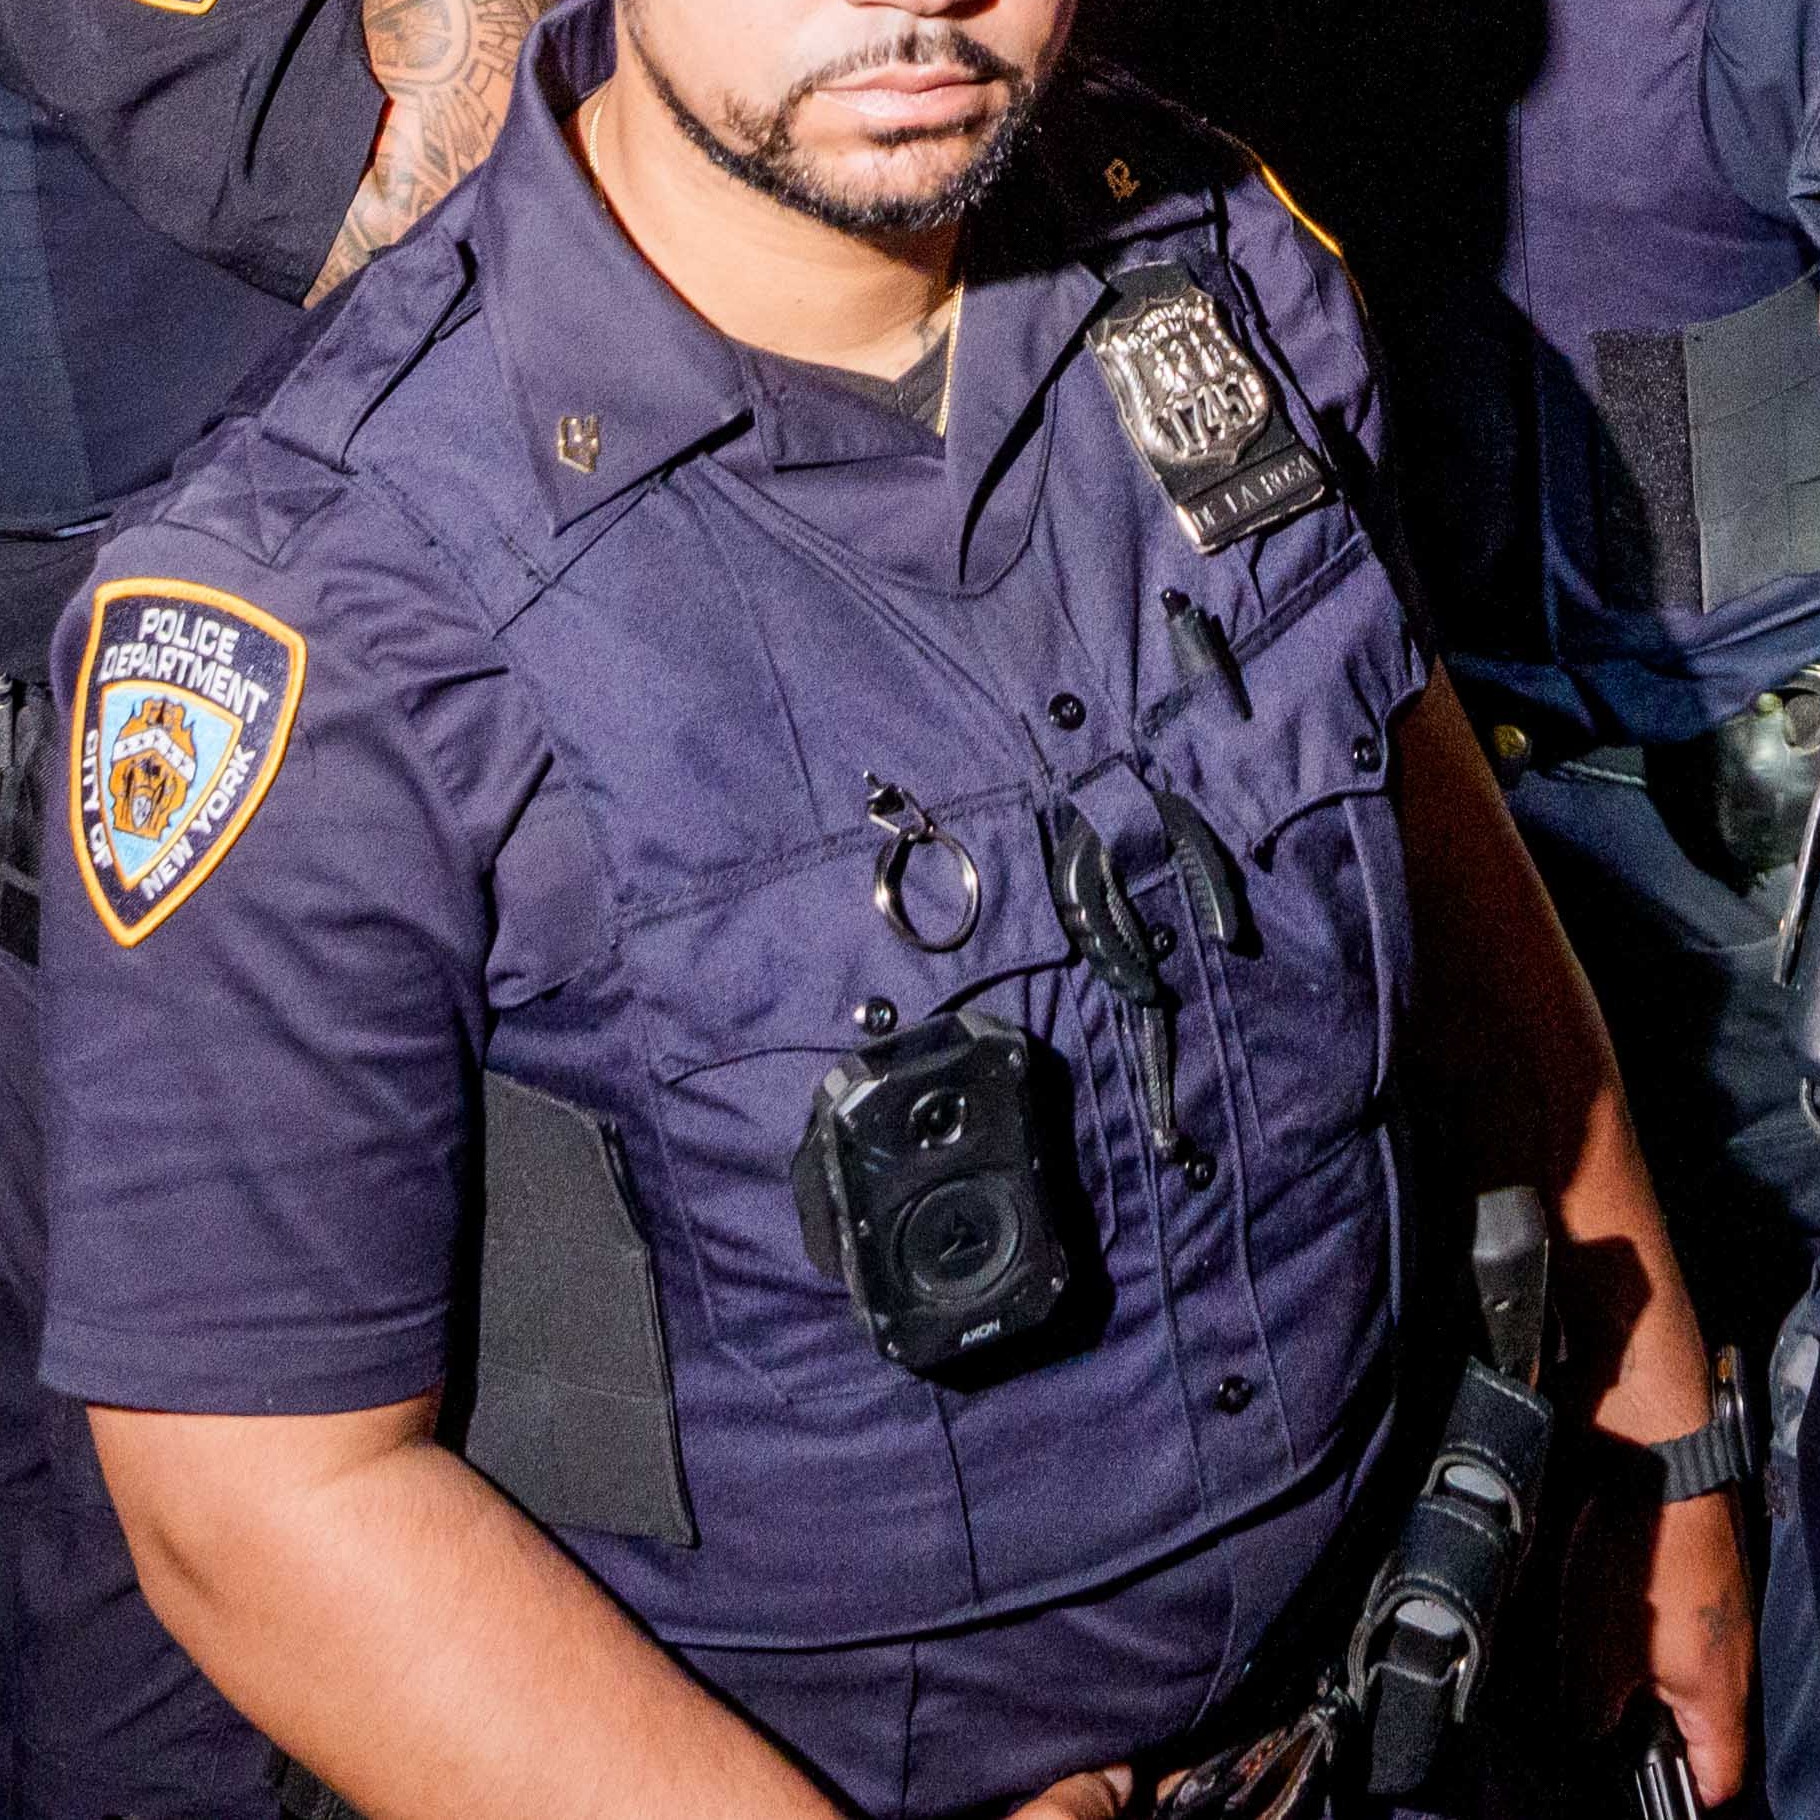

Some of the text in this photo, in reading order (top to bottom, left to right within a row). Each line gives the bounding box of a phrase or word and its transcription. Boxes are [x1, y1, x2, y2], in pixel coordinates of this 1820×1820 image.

[138, 607, 240, 663] POLICE
[101, 643, 270, 724] DEPARTMENT
[82, 728, 115, 869] CITY OF
[140, 743, 259, 902] NEW YORK
[960, 1319, 1001, 1347] AXON
